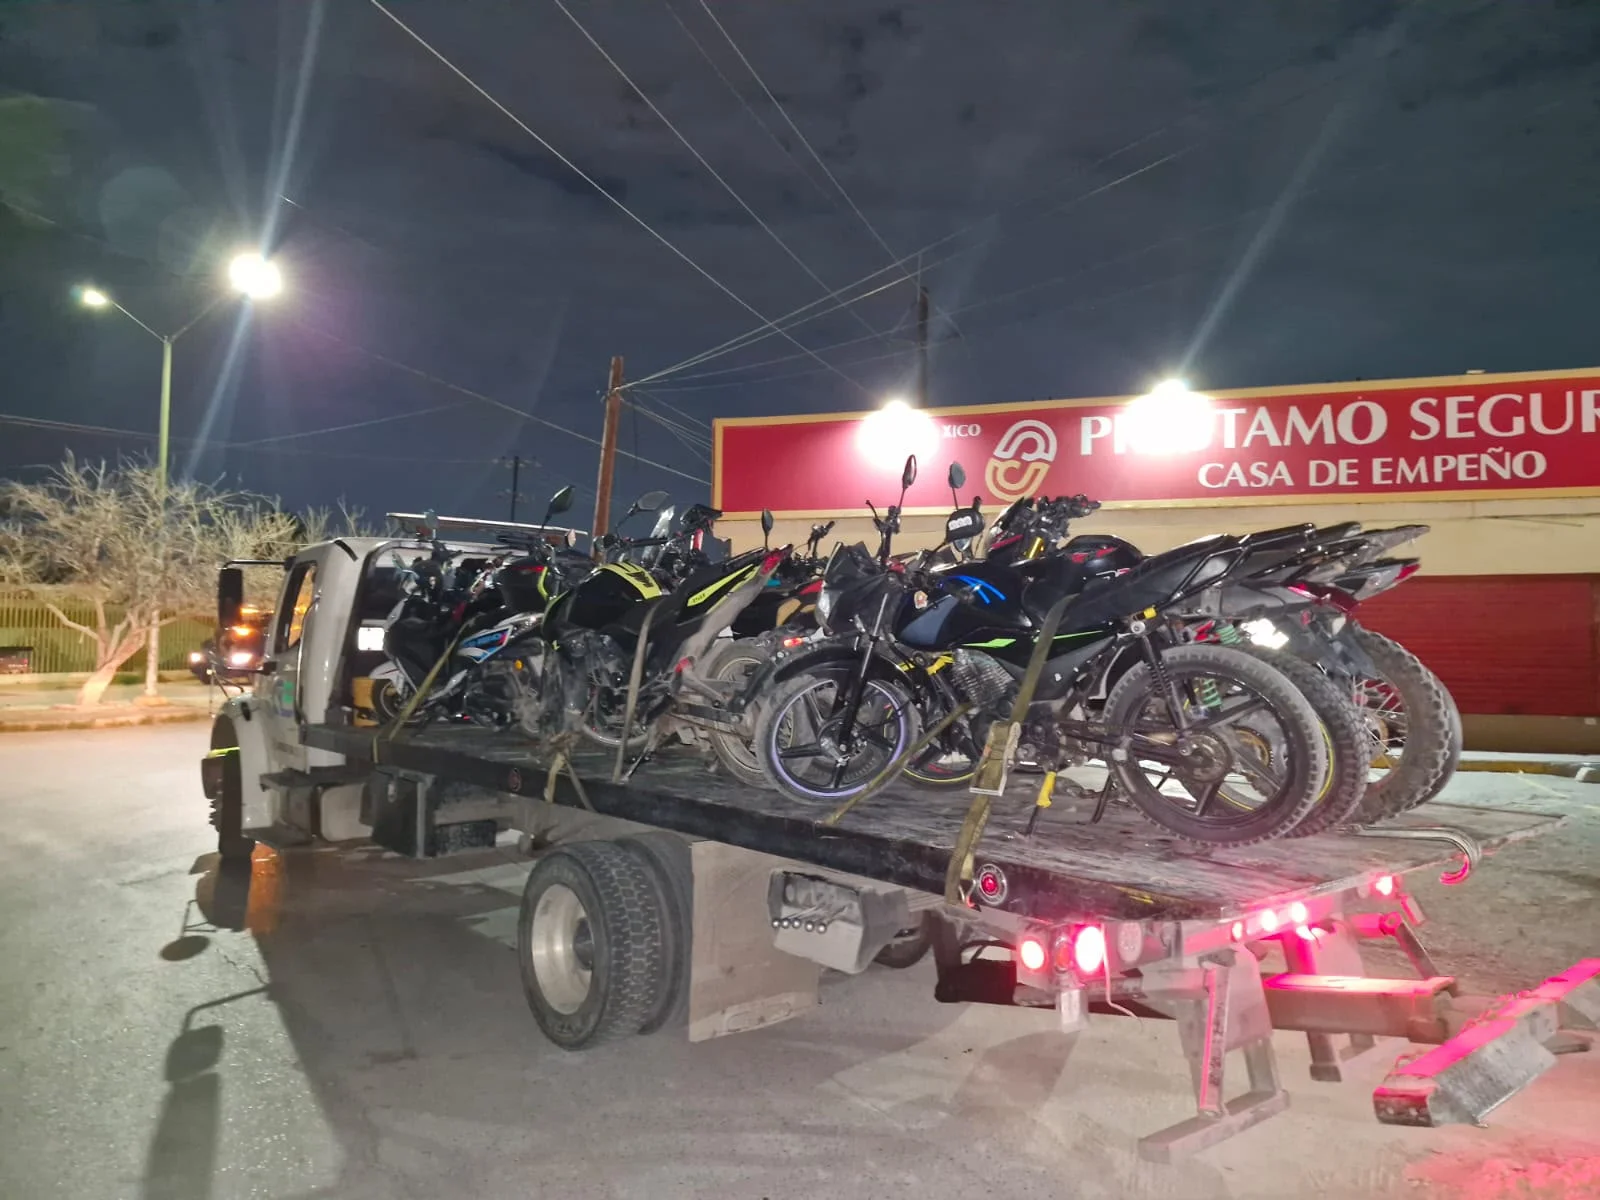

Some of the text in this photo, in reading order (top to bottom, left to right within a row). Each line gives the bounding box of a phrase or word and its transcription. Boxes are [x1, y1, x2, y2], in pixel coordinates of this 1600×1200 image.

[940, 423, 982, 438] XICO
[1080, 401, 1388, 456] PTAMO
[1198, 446, 1547, 488] CASA DE EMPEÑO
